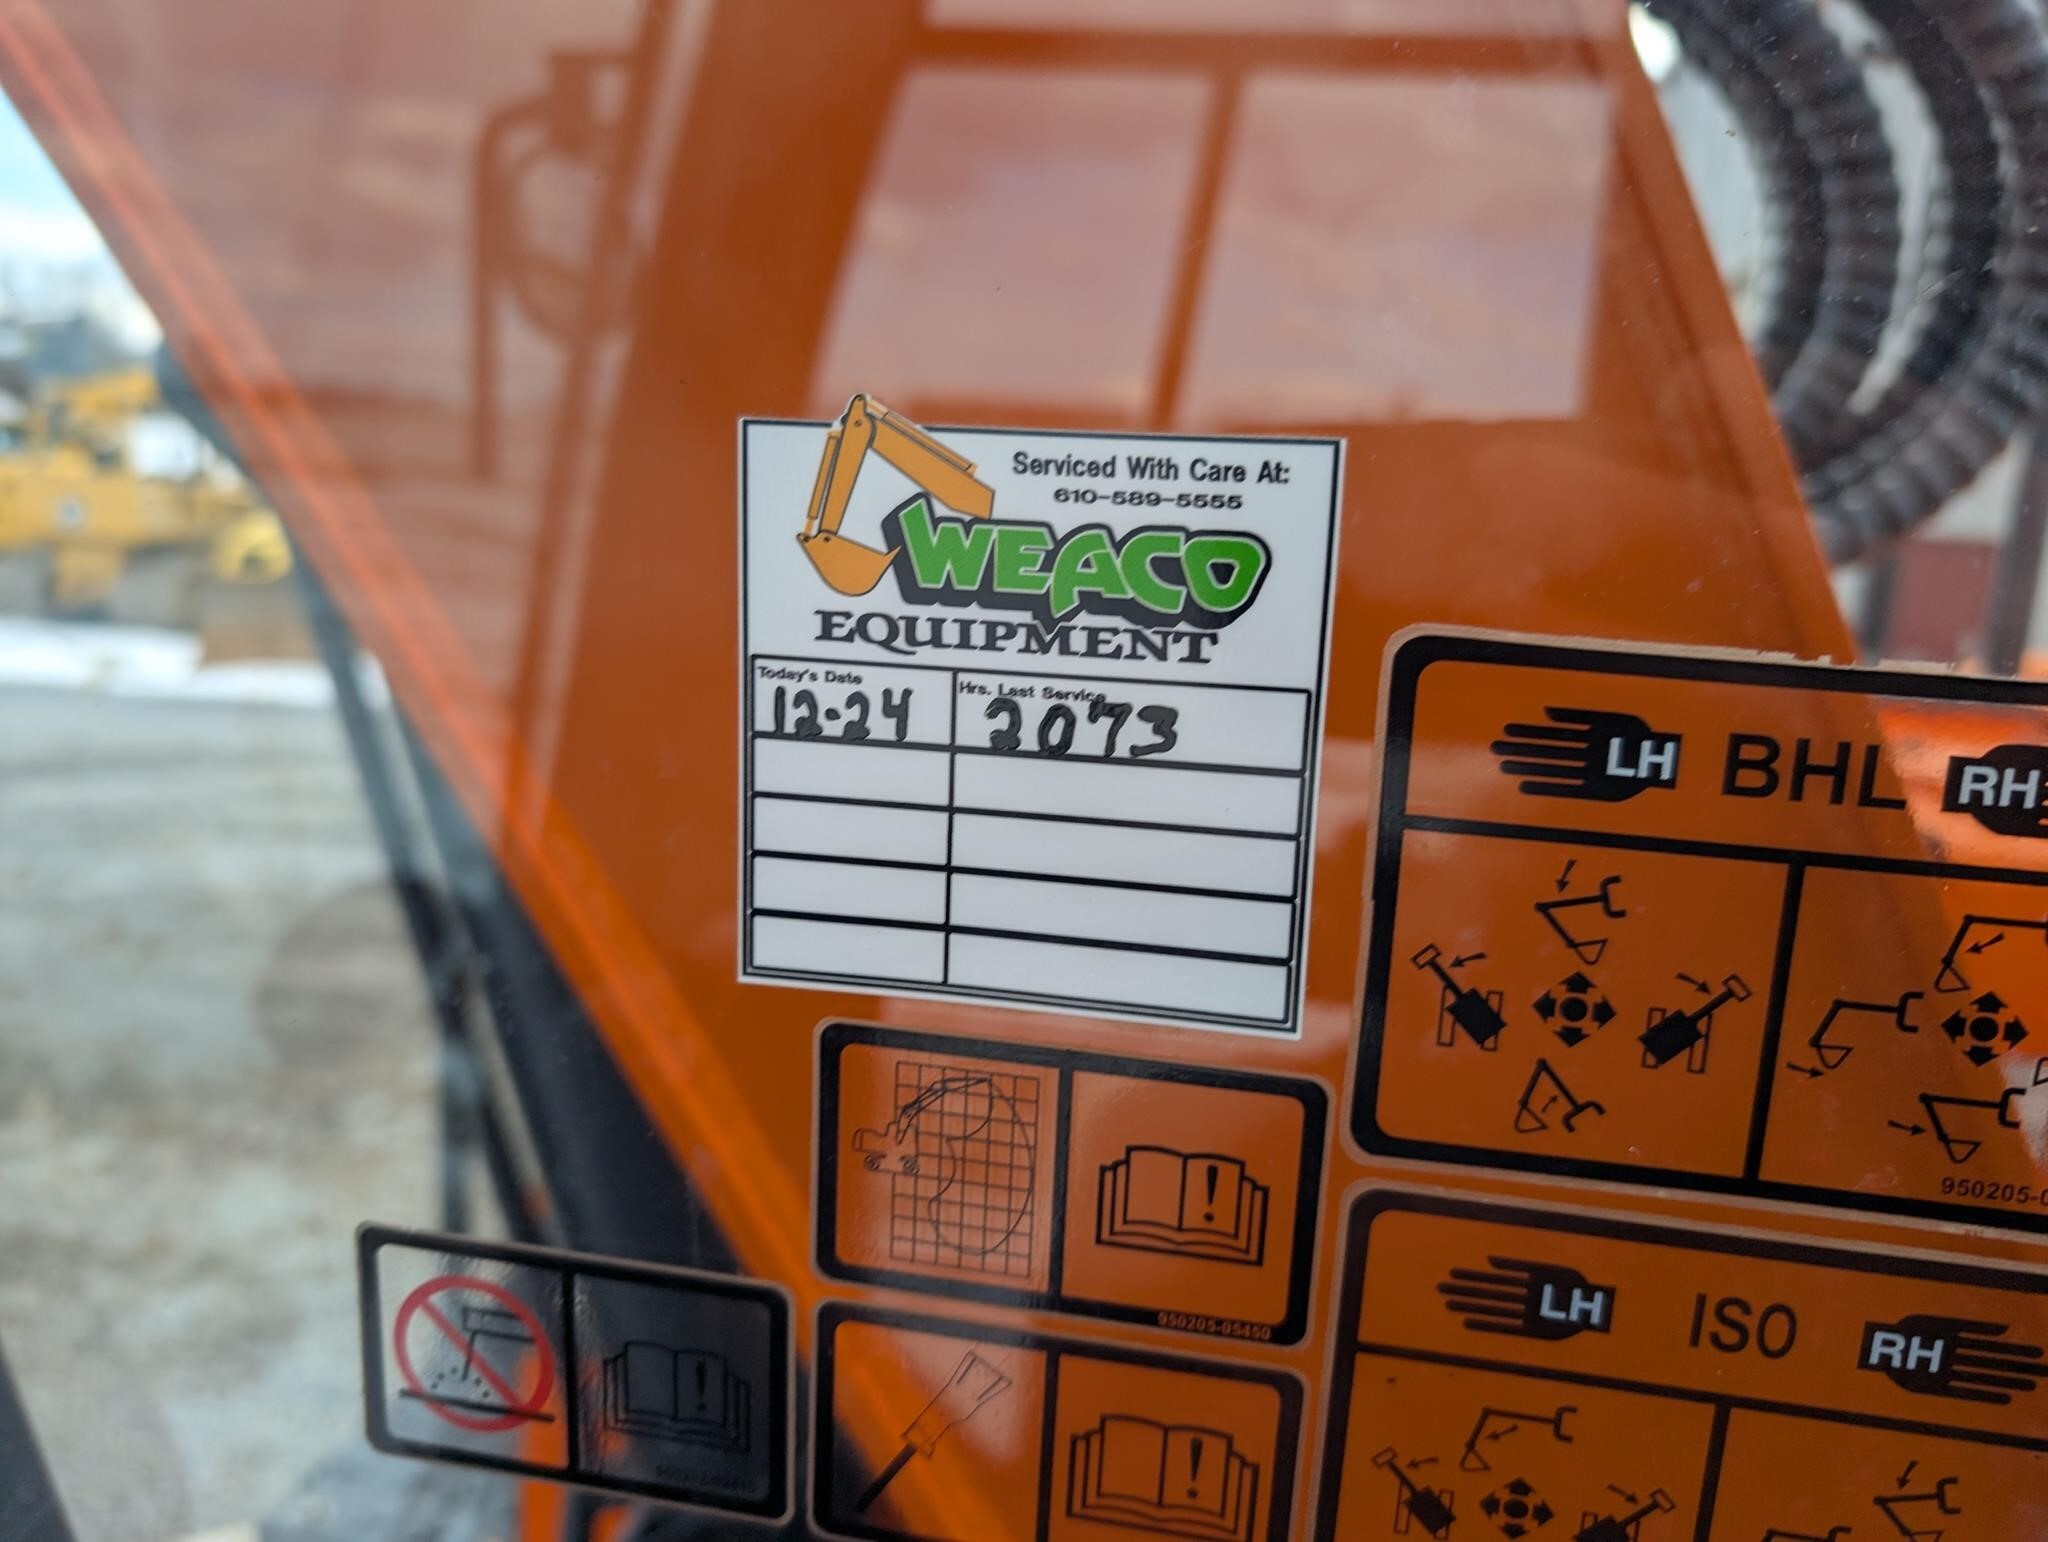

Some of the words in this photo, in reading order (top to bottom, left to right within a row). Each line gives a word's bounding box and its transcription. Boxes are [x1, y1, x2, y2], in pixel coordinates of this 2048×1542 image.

[1013, 451, 1116, 479] Serviced
[1127, 456, 1179, 481] With
[1190, 458, 1247, 483] Care
[1257, 460, 1290, 484] At:
[1053, 487, 1243, 510] 610-589-5555
[892, 495, 1268, 622] WEACO
[814, 609, 1219, 664] EQUIPMENT
[757, 666, 818, 683] Today's
[824, 670, 863, 685] Date
[959, 681, 992, 696] Hrs.
[998, 683, 1035, 699] Last
[1041, 687, 1106, 703] Service
[984, 697, 1179, 758] 2073
[1605, 735, 1680, 781] LH
[1722, 732, 1908, 811] BHL
[1957, 764, 2041, 810] RH
[1540, 1282, 1605, 1327] LH
[1689, 1292, 1798, 1359] ISO
[1868, 1330, 1946, 1374] RH
